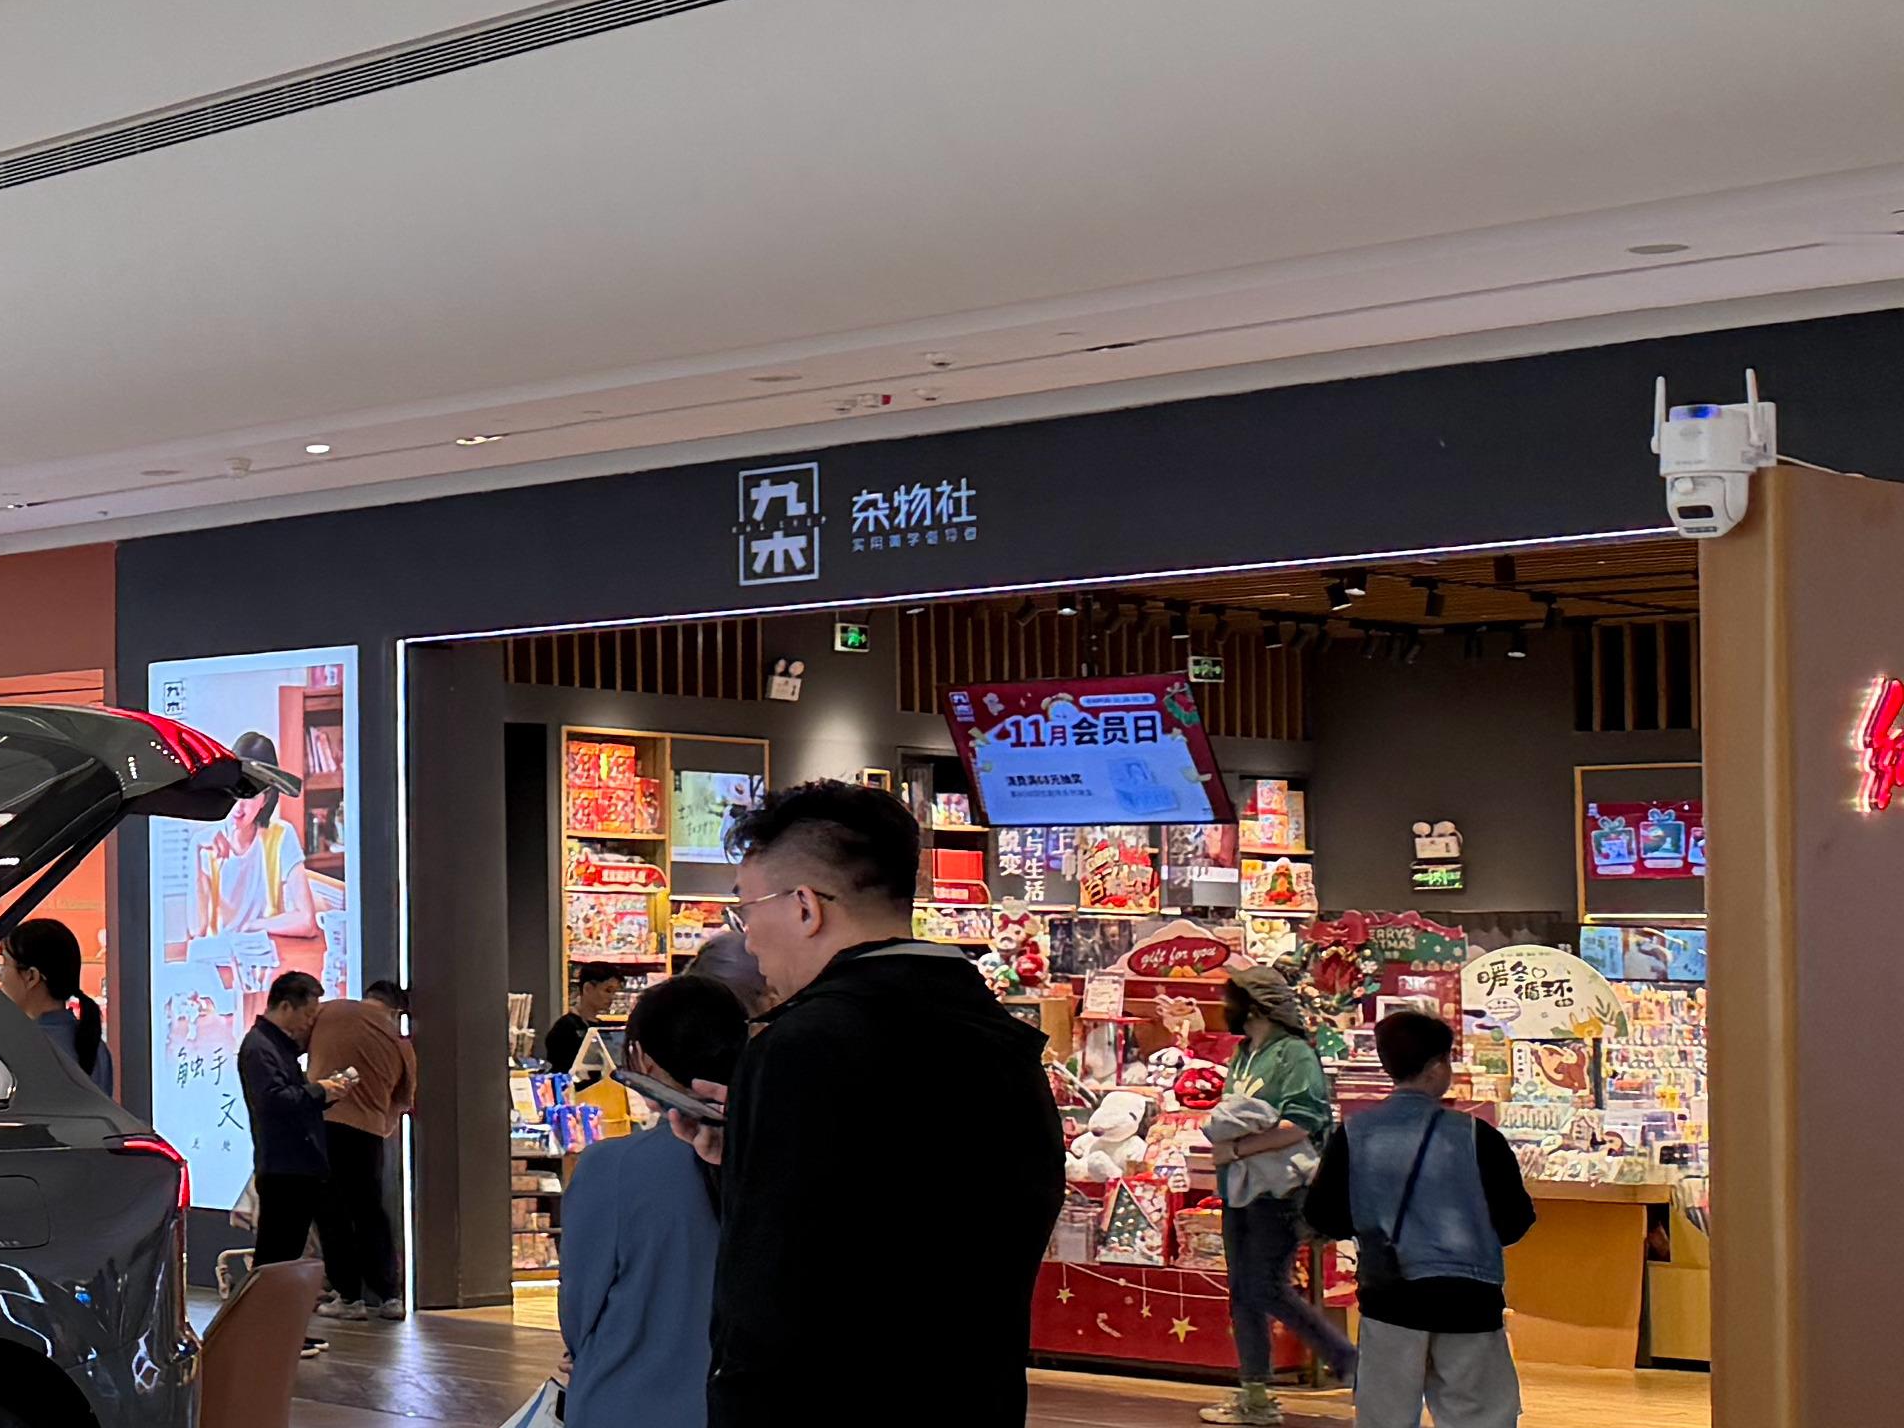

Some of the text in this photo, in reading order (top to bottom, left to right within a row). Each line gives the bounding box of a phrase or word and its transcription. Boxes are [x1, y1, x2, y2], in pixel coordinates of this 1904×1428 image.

[851, 477, 977, 533] 杂物社
[1009, 714, 1159, 748] 11月会员日
